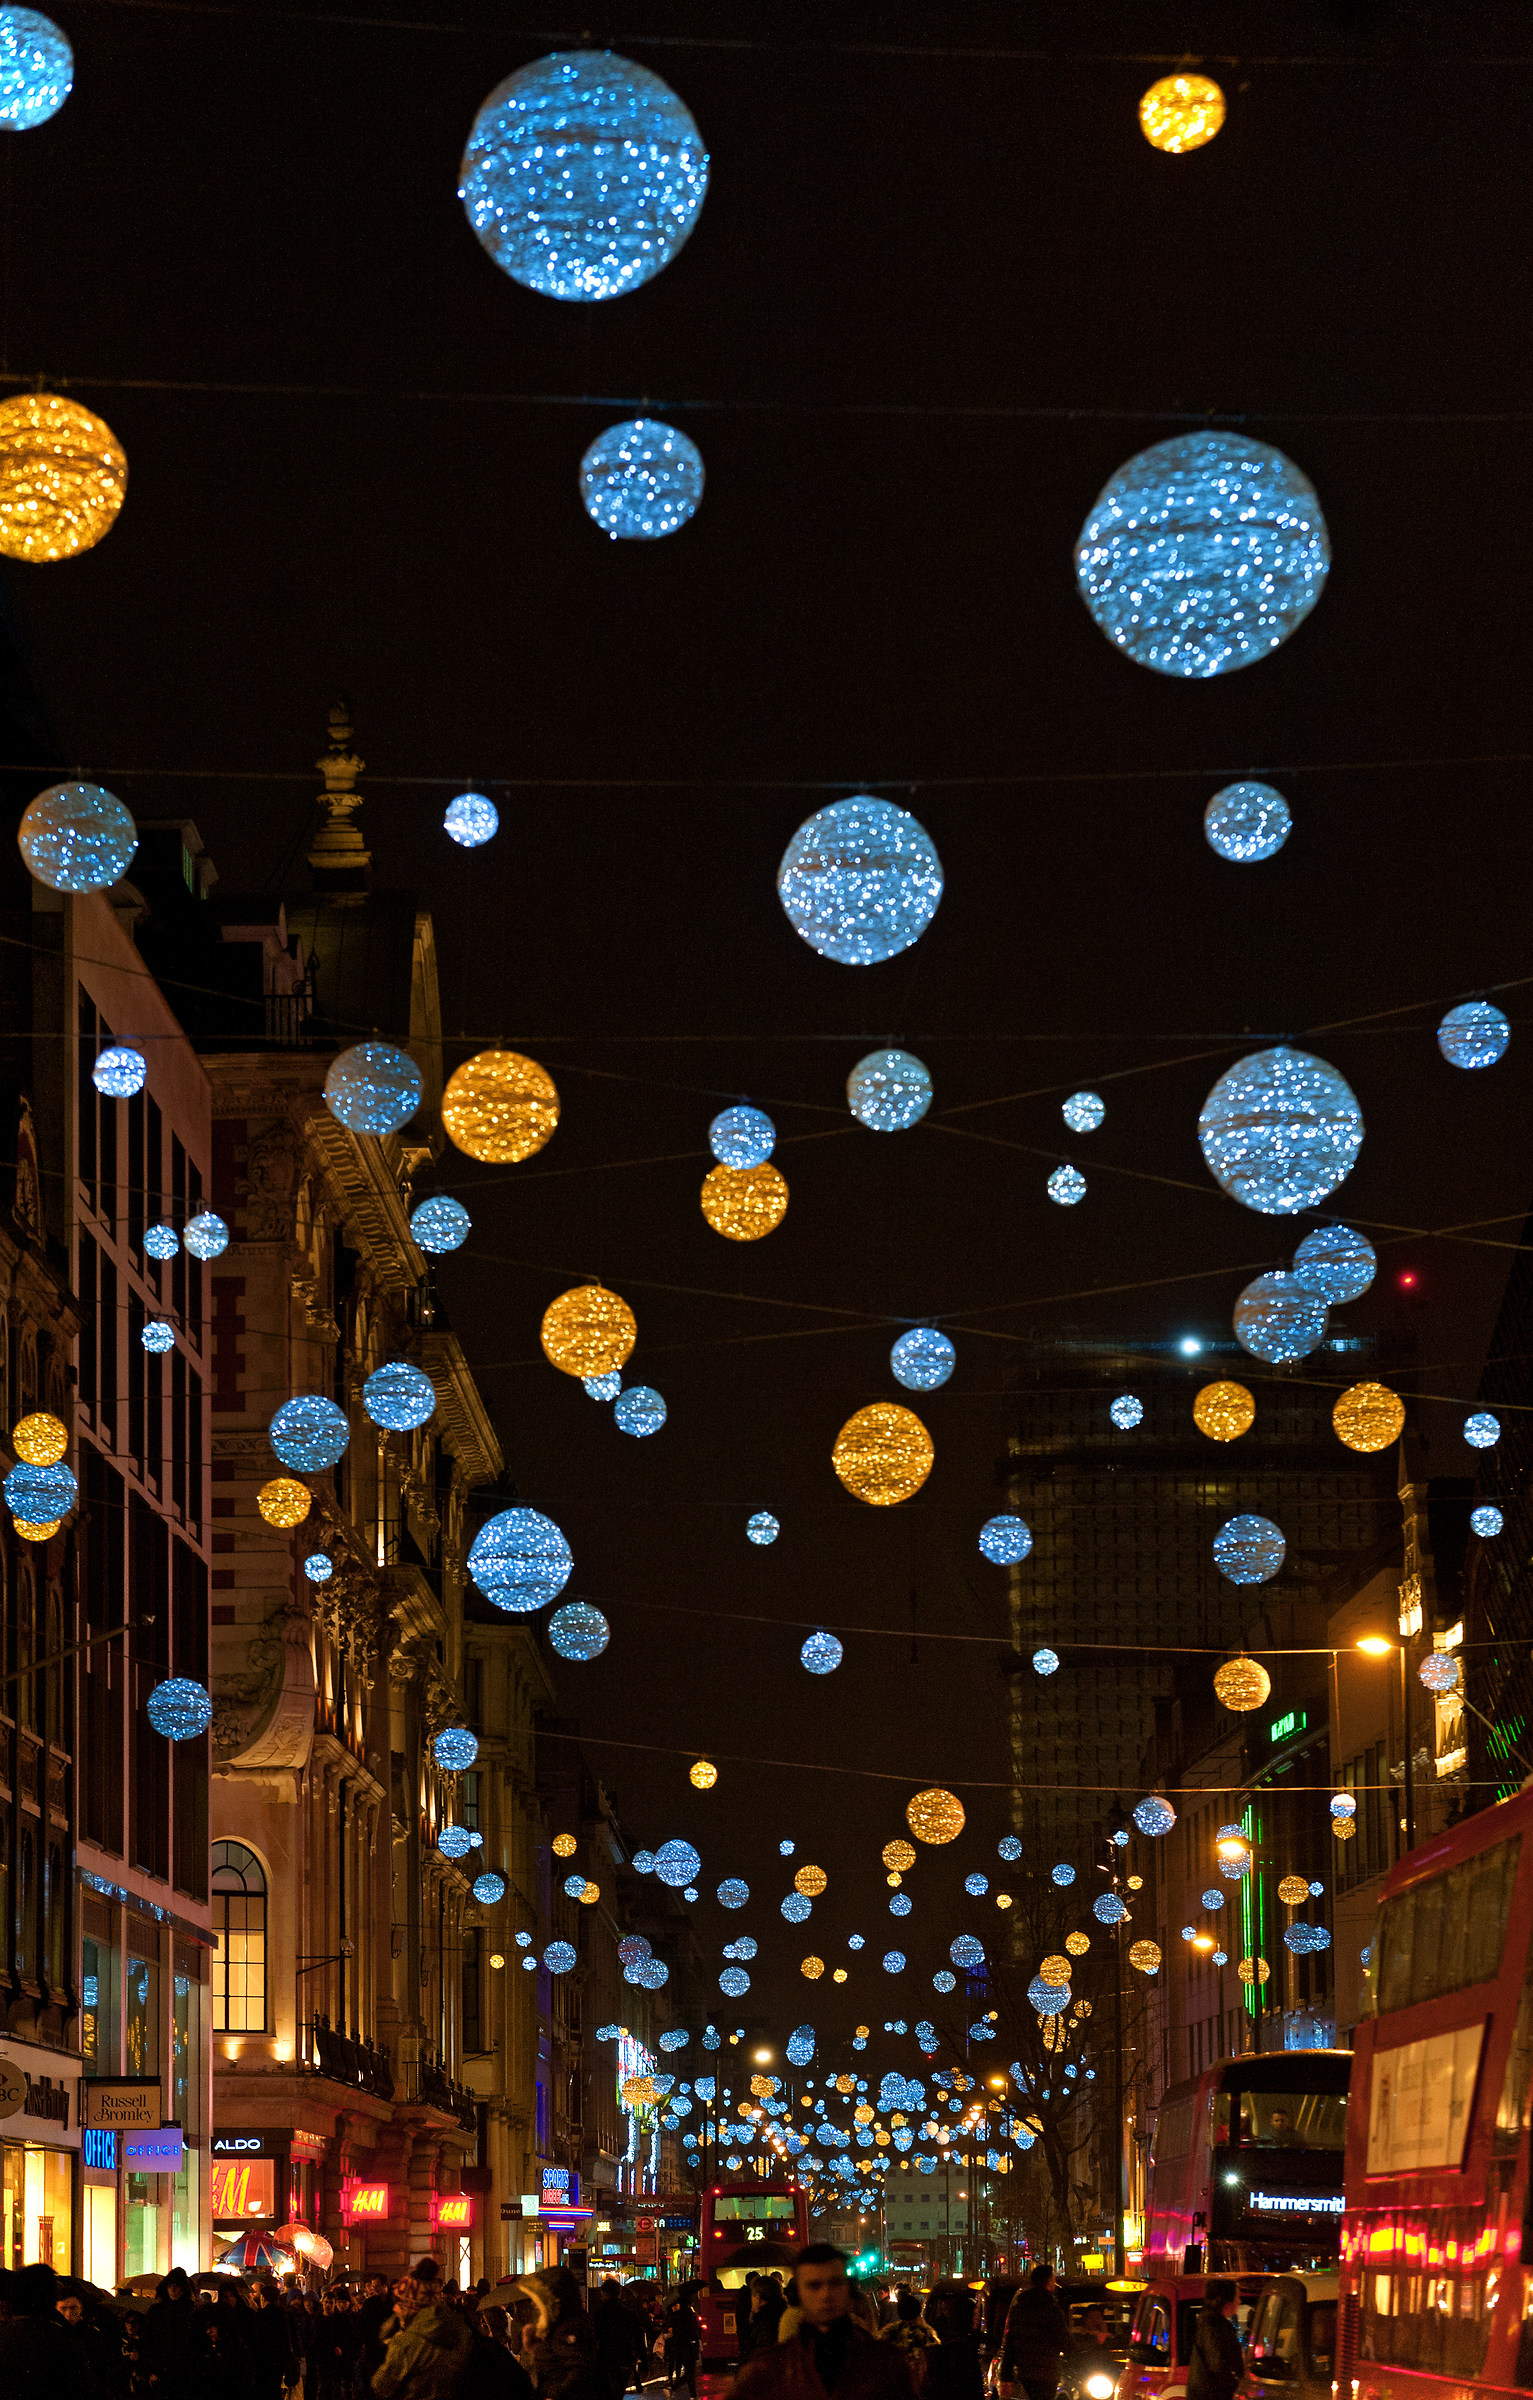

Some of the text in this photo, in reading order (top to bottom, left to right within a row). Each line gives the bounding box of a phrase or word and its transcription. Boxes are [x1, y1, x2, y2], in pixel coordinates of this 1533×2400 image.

[101, 2094, 147, 2108] Russell
[85, 2129, 115, 2170] OFFICE
[125, 2145, 180, 2156] OFFICE
[214, 2139, 261, 2150] ALDO
[542, 2168, 570, 2189] SPORTS
[352, 2190, 386, 2212] H&M
[439, 2201, 468, 2221] H&M
[746, 2226, 764, 2241] 25
